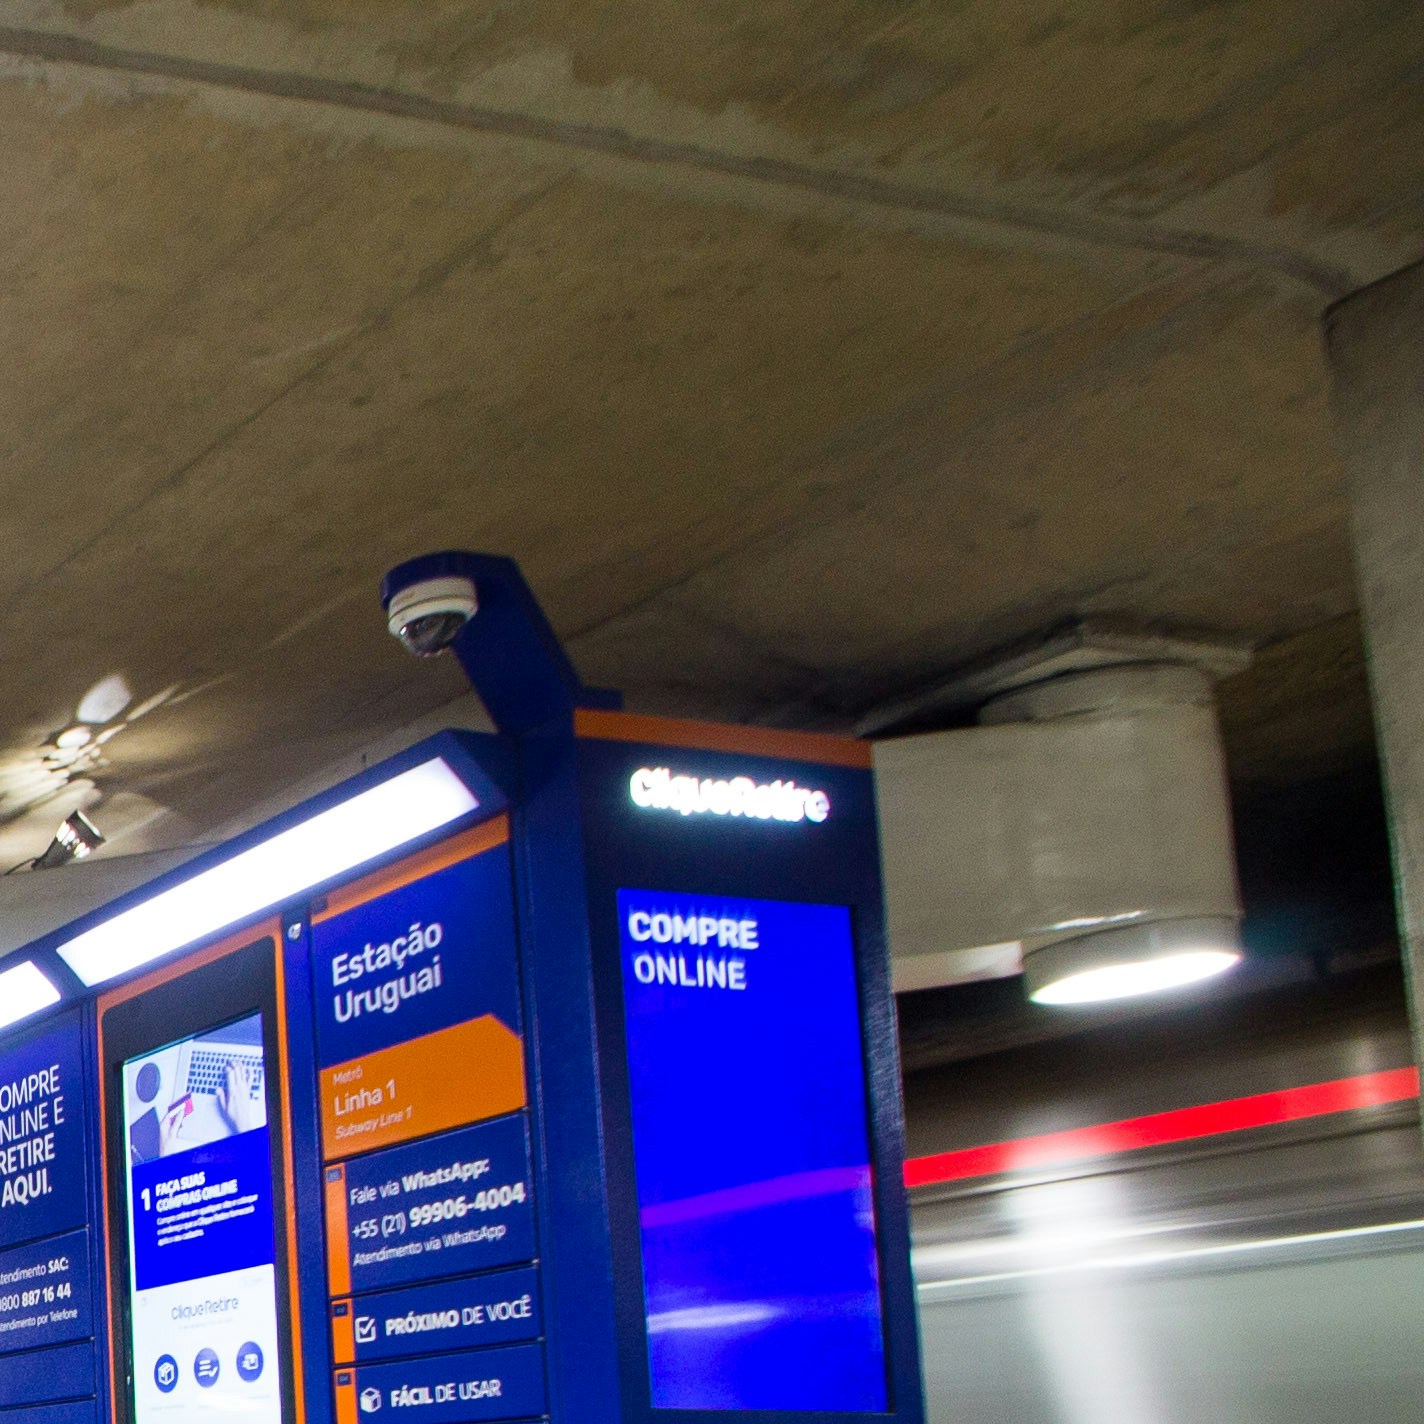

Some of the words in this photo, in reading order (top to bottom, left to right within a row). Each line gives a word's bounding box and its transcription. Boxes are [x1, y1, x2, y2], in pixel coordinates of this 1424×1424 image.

[628, 911, 759, 950] COMPRE
[332, 922, 443, 987] Estação
[633, 954, 747, 991] ONLINE
[333, 955, 443, 1024] Uruguai
[54, 1096, 65, 1125] E
[333, 1087, 383, 1117] Linha
[385, 1079, 396, 1100] 1
[404, 1105, 413, 1120] 1
[1, 1168, 52, 1208] AQUI.
[140, 1188, 150, 1211] 1
[350, 1186, 377, 1206] Fale
[379, 1181, 400, 1199] via
[402, 1158, 490, 1193] WhatsApp:
[352, 1219, 379, 1240] +55
[381, 1212, 407, 1238] (21)
[409, 1182, 526, 1228] 99906-4004
[353, 1242, 422, 1267] Atendimento
[424, 1236, 442, 1251] via
[442, 1224, 506, 1248] WhatsApp
[48, 1257, 69, 1275] SAC:
[21, 1288, 41, 1308] 887
[42, 1285, 54, 1303] 16
[56, 1282, 71, 1300] 44
[37, 1313, 48, 1327] por
[50, 1307, 78, 1324] Telefone
[385, 1308, 459, 1336] PRÓXIMO
[462, 1306, 483, 1325] DE
[487, 1294, 532, 1322] VOCÊ
[391, 1384, 433, 1408] FÁCIL
[435, 1382, 456, 1403] DE
[459, 1379, 502, 1400] USAR
